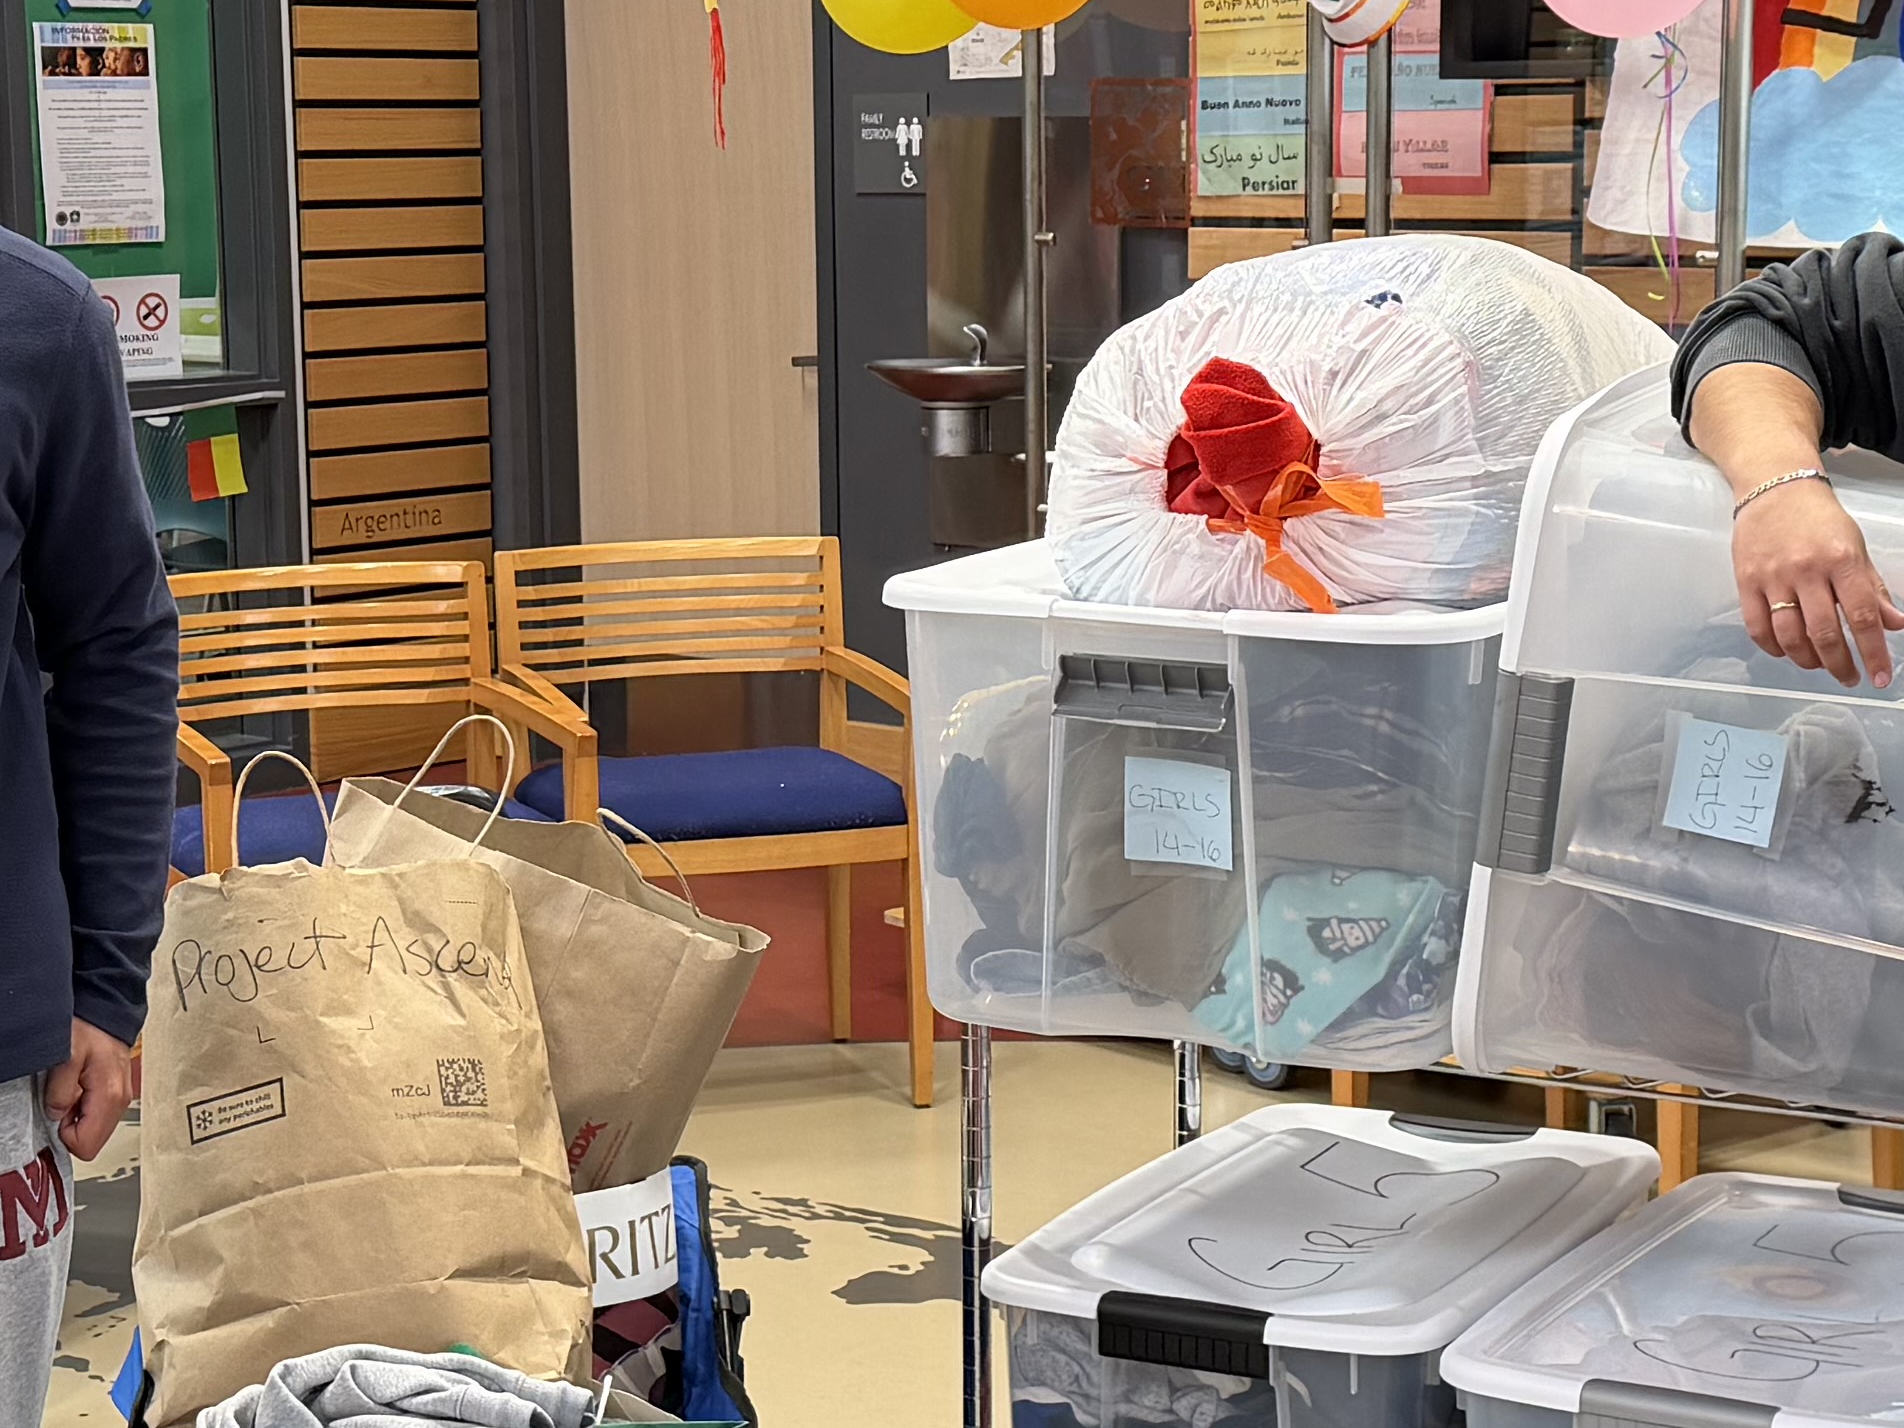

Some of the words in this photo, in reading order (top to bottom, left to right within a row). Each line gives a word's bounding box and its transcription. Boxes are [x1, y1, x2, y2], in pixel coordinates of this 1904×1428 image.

[118, 332, 159, 344] MOKING
[340, 505, 443, 540] Argentina
[1128, 783, 1221, 819] GIRLS
[1688, 728, 1731, 830] GIRLS
[1733, 752, 1774, 834] 14-16
[1154, 827, 1222, 863] 14-16
[171, 916, 347, 1013] Project
[585, 1203, 676, 1284] RITZ
[1187, 1211, 1418, 1291] GIRL
[1632, 1312, 1888, 1383] GIRL
